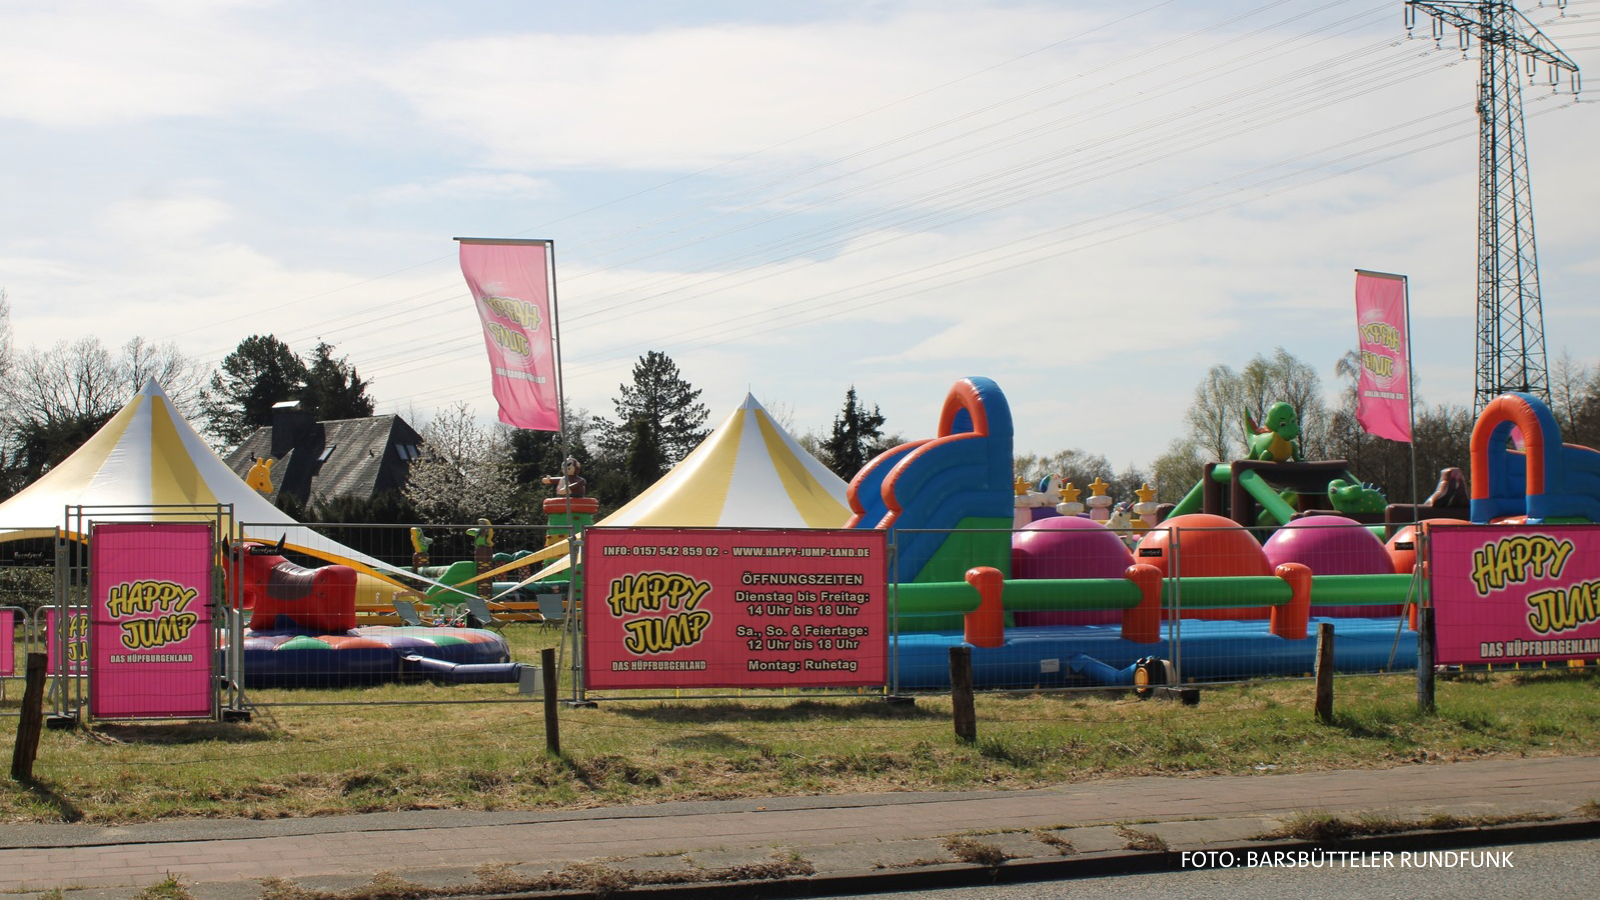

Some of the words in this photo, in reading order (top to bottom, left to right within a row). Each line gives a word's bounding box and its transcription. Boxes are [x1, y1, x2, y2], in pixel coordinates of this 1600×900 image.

[603, 547, 631, 556] INFO:
[632, 547, 657, 556] 0157
[659, 547, 680, 556] 542
[682, 547, 703, 556] 859
[705, 547, 719, 556] 02
[733, 547, 869, 557] WWW.HAPPY-JUMP-LAND.DE
[1472, 535, 1573, 595] HAPPY
[742, 572, 863, 585] ÖFFNUNGSZEITEN
[107, 581, 197, 617] HAPPY
[608, 573, 710, 616] HAPPY
[736, 591, 793, 604] Dienstag
[797, 591, 817, 602] bis
[821, 591, 869, 604] Freitag:
[747, 606, 763, 616] 14
[767, 605, 790, 616] Uhr
[794, 605, 814, 616] bis
[817, 605, 832, 616] 18
[836, 605, 858, 616] Uhr
[121, 613, 197, 649] JUMP
[625, 612, 710, 653] JUMP
[737, 626, 762, 638] Sa.,
[766, 626, 787, 637] So.
[791, 626, 801, 636] &
[805, 626, 868, 639] Feiertage:
[747, 640, 763, 650] 12
[767, 639, 790, 650] Uhr
[794, 639, 814, 650] bis
[817, 639, 832, 650] 18
[836, 639, 858, 649] Uhr
[1481, 642, 1503, 657] DAS
[1506, 639, 1600, 657] HÜPFBURGENLAN
[110, 654, 125, 663] DAS
[127, 653, 193, 663] HÜPFBURGENLAND
[612, 661, 629, 671] DAS
[631, 659, 706, 671] HÜPFBURGENLAND
[748, 660, 801, 672] Montag:
[805, 660, 857, 672] Ruhetag
